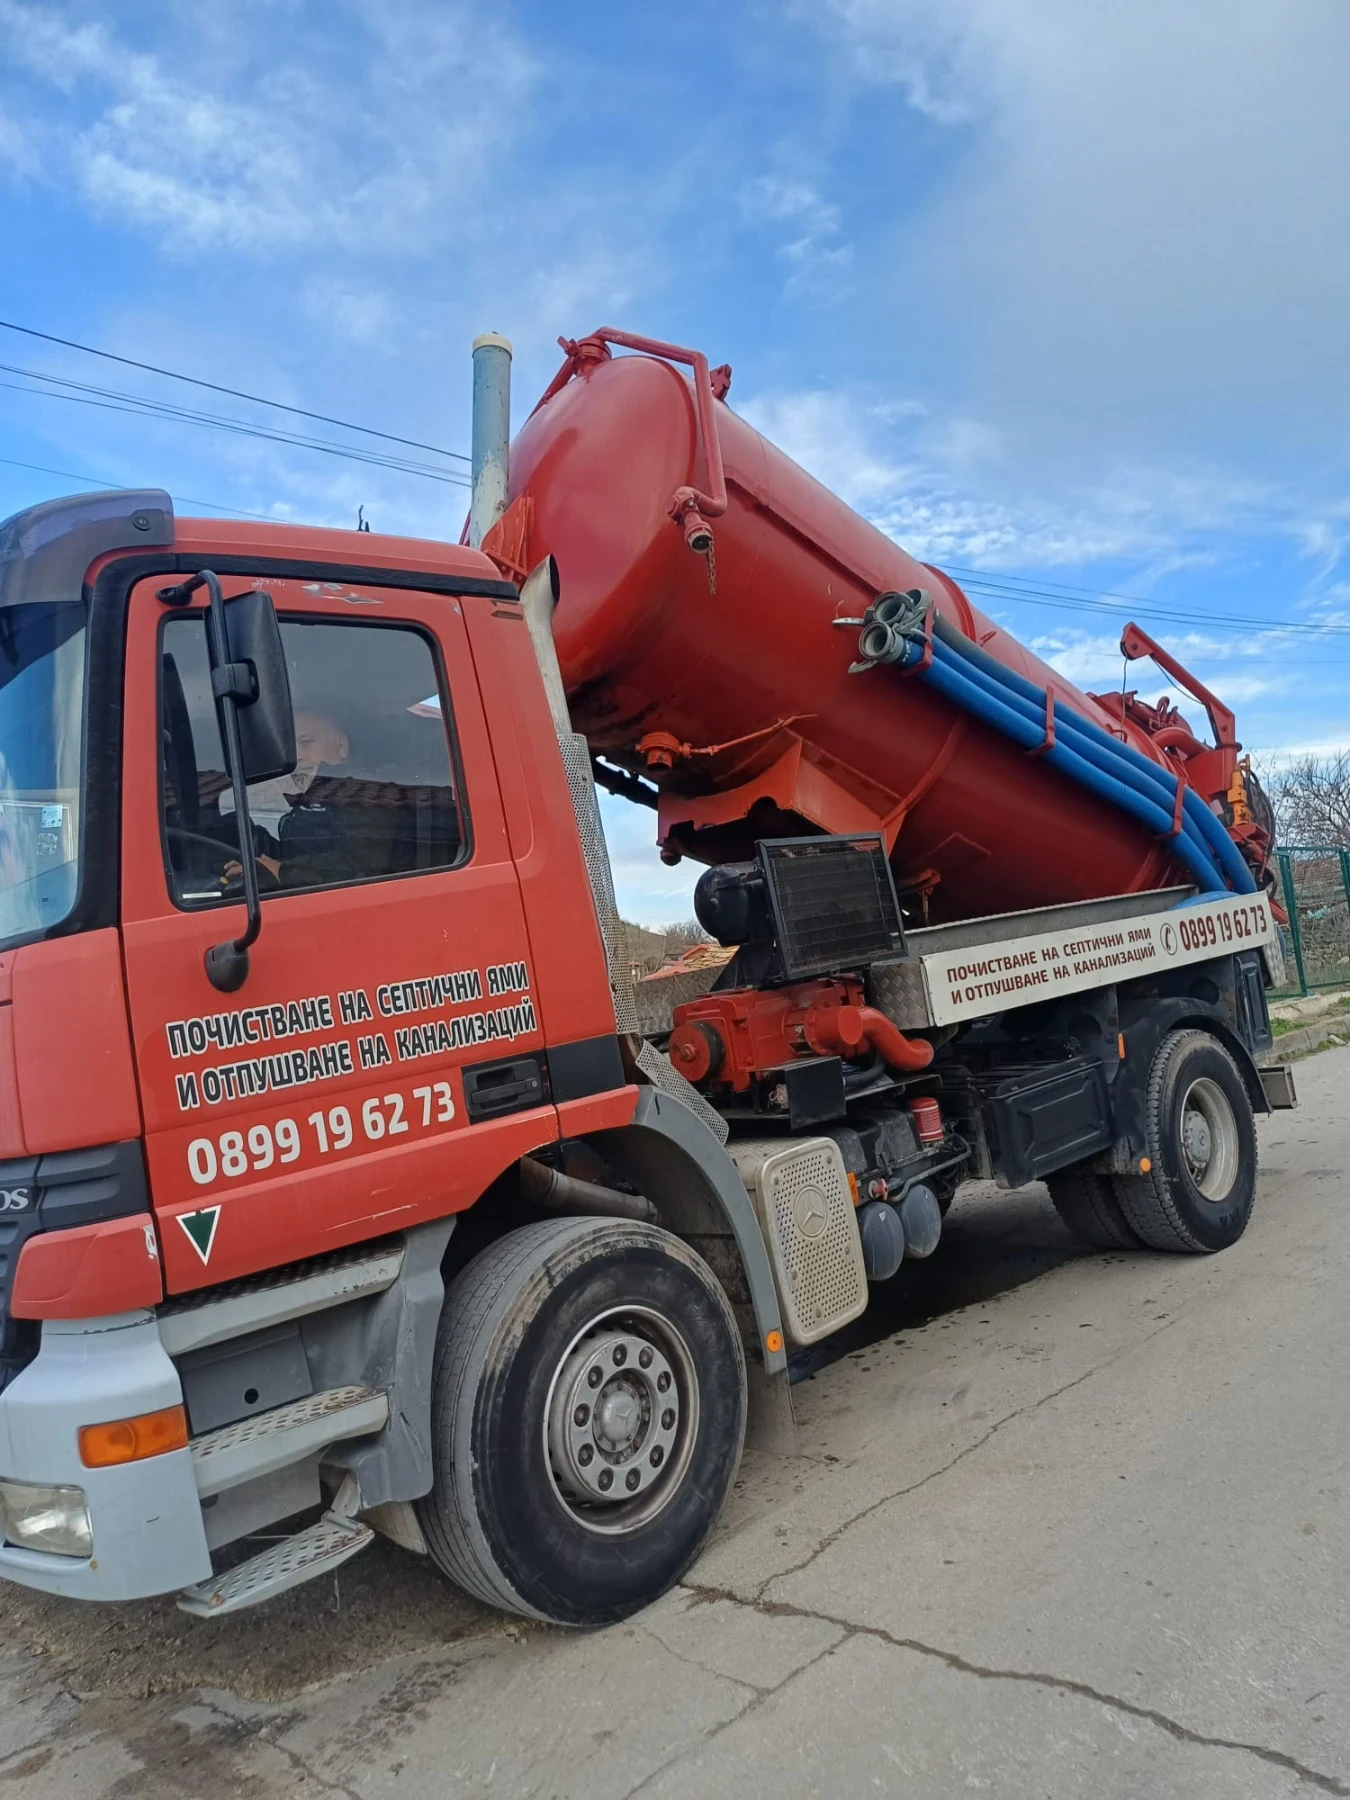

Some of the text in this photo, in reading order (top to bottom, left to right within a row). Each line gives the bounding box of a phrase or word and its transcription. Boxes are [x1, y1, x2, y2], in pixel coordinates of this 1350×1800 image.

[946, 928, 1152, 983] ПОЧИСТВАНЕ НА СЕПТИЧНИ ЯМИ
[1179, 904, 1267, 951] 0899 19 62 73
[166, 961, 529, 1059] ПОЧИСТВАНЕ НА СЕПТИЧНИ ЯМИ
[951, 943, 1156, 1004] И ОТПУШВАНЕ НА КАНАЛИЗАЦИЙ
[175, 998, 537, 1110] И ОТПУШВАНЕ НА КАНАЛИЗАЦИЙ
[188, 1081, 455, 1184] 0899 19 62 73
